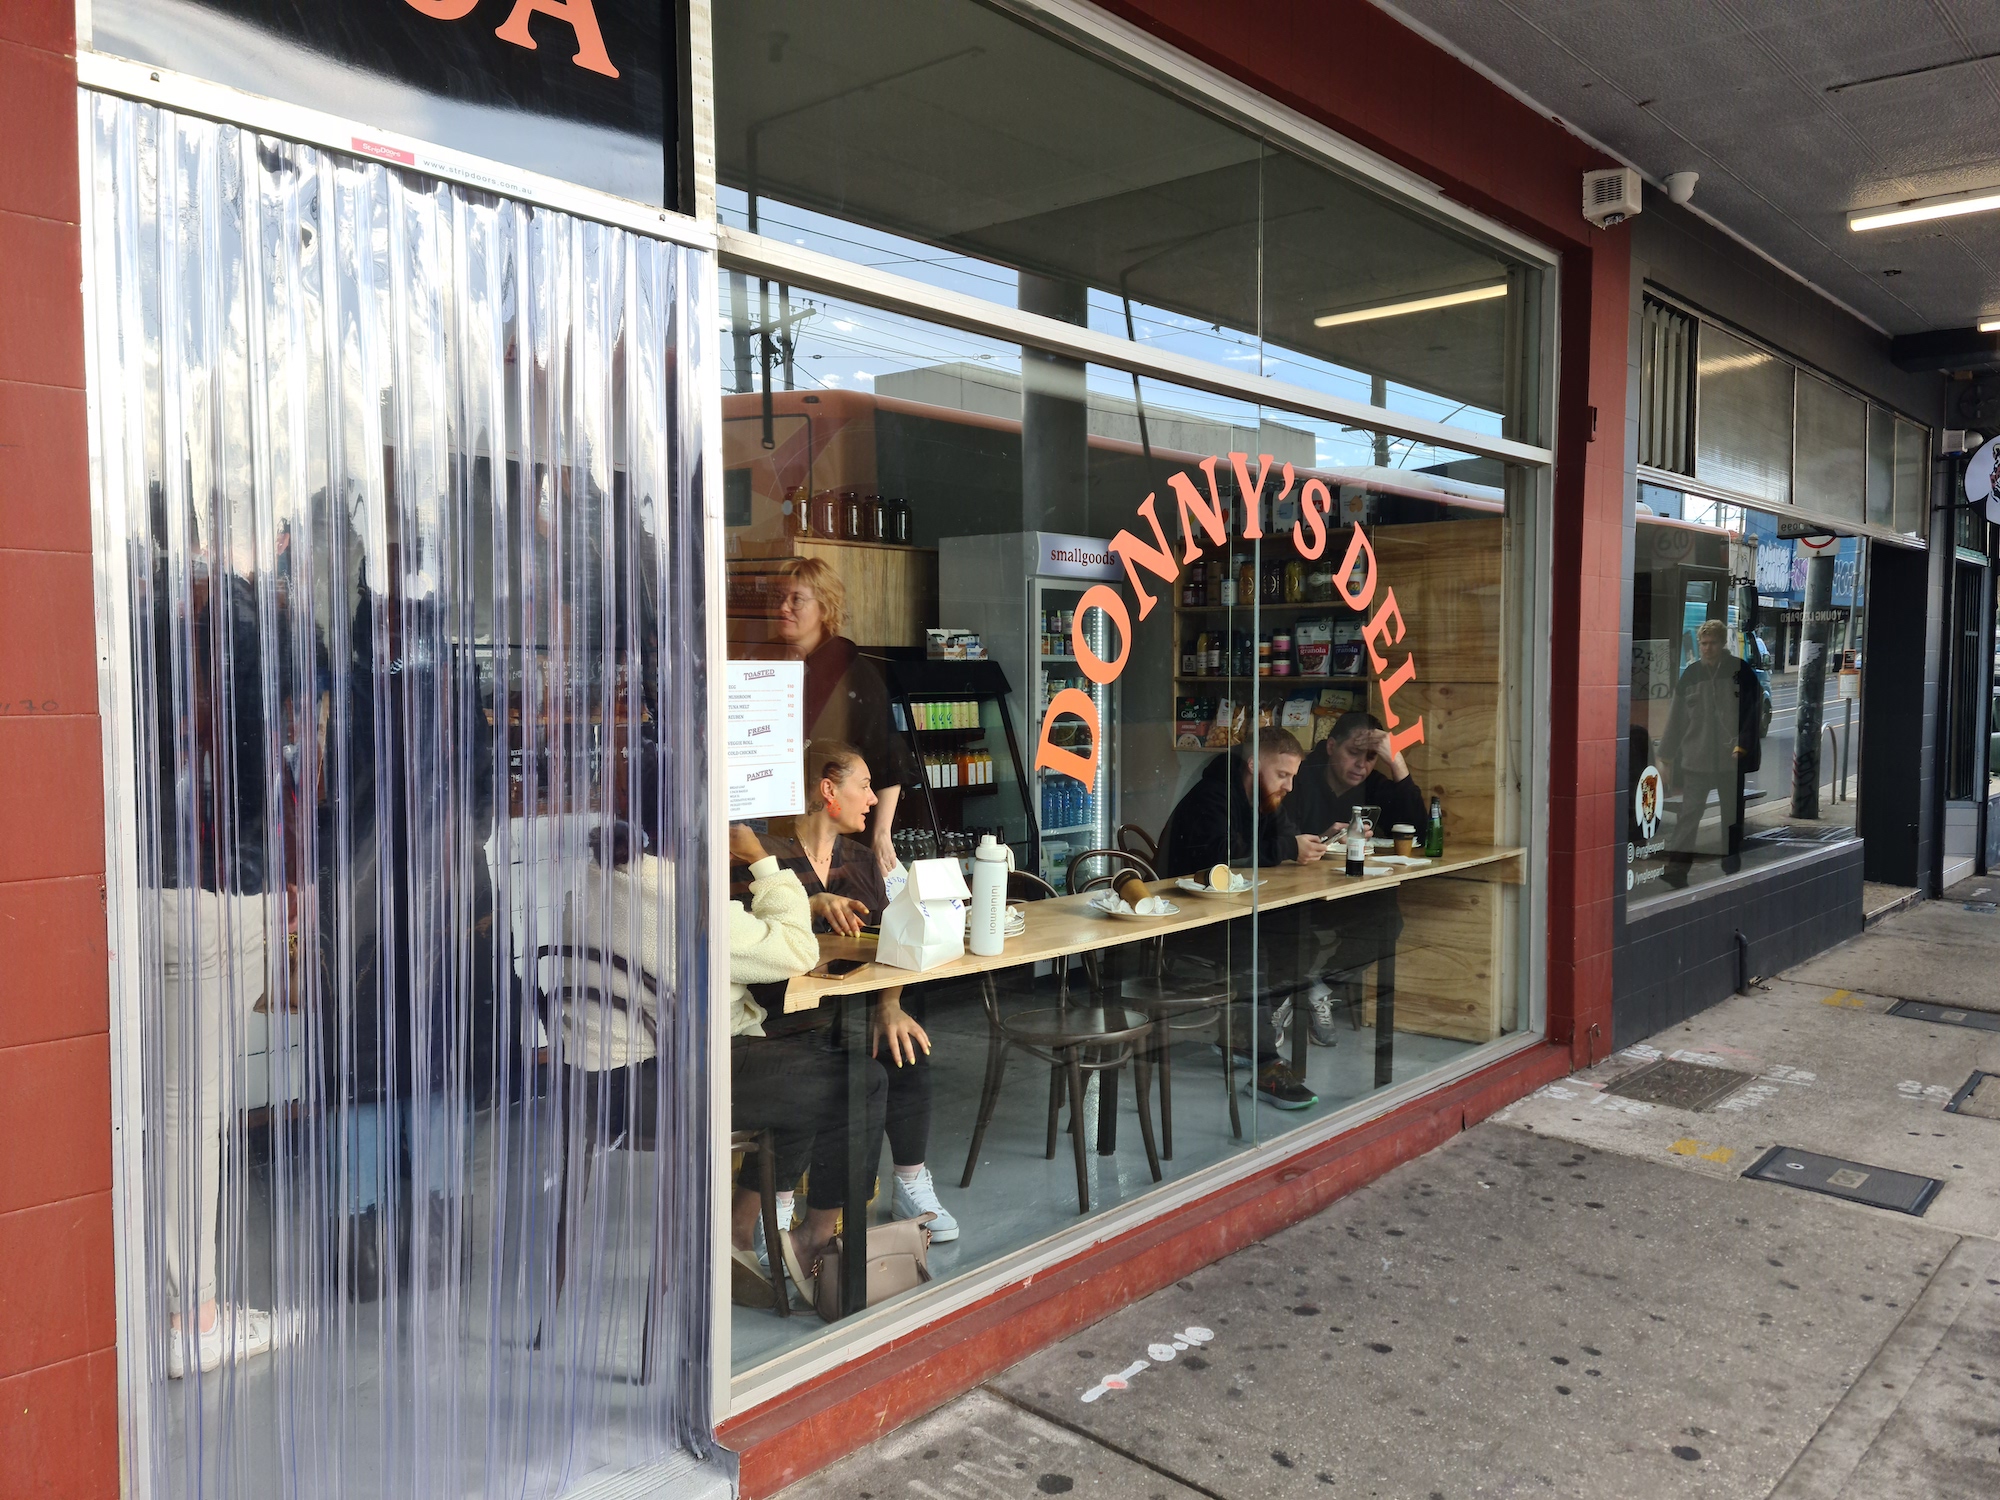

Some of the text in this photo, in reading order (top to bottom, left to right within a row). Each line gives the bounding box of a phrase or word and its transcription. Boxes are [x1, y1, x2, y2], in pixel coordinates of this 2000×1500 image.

[423, 159, 533, 196] www.stripdoors.com.au
[1050, 548, 1115, 567] smallgoods
[1034, 452, 1425, 794] DONNY'S DELI
[743, 669, 775, 681] TOASTED
[747, 725, 771, 737] FRESH
[746, 769, 774, 782] PANTRY
[989, 885, 1001, 935] lululemon
